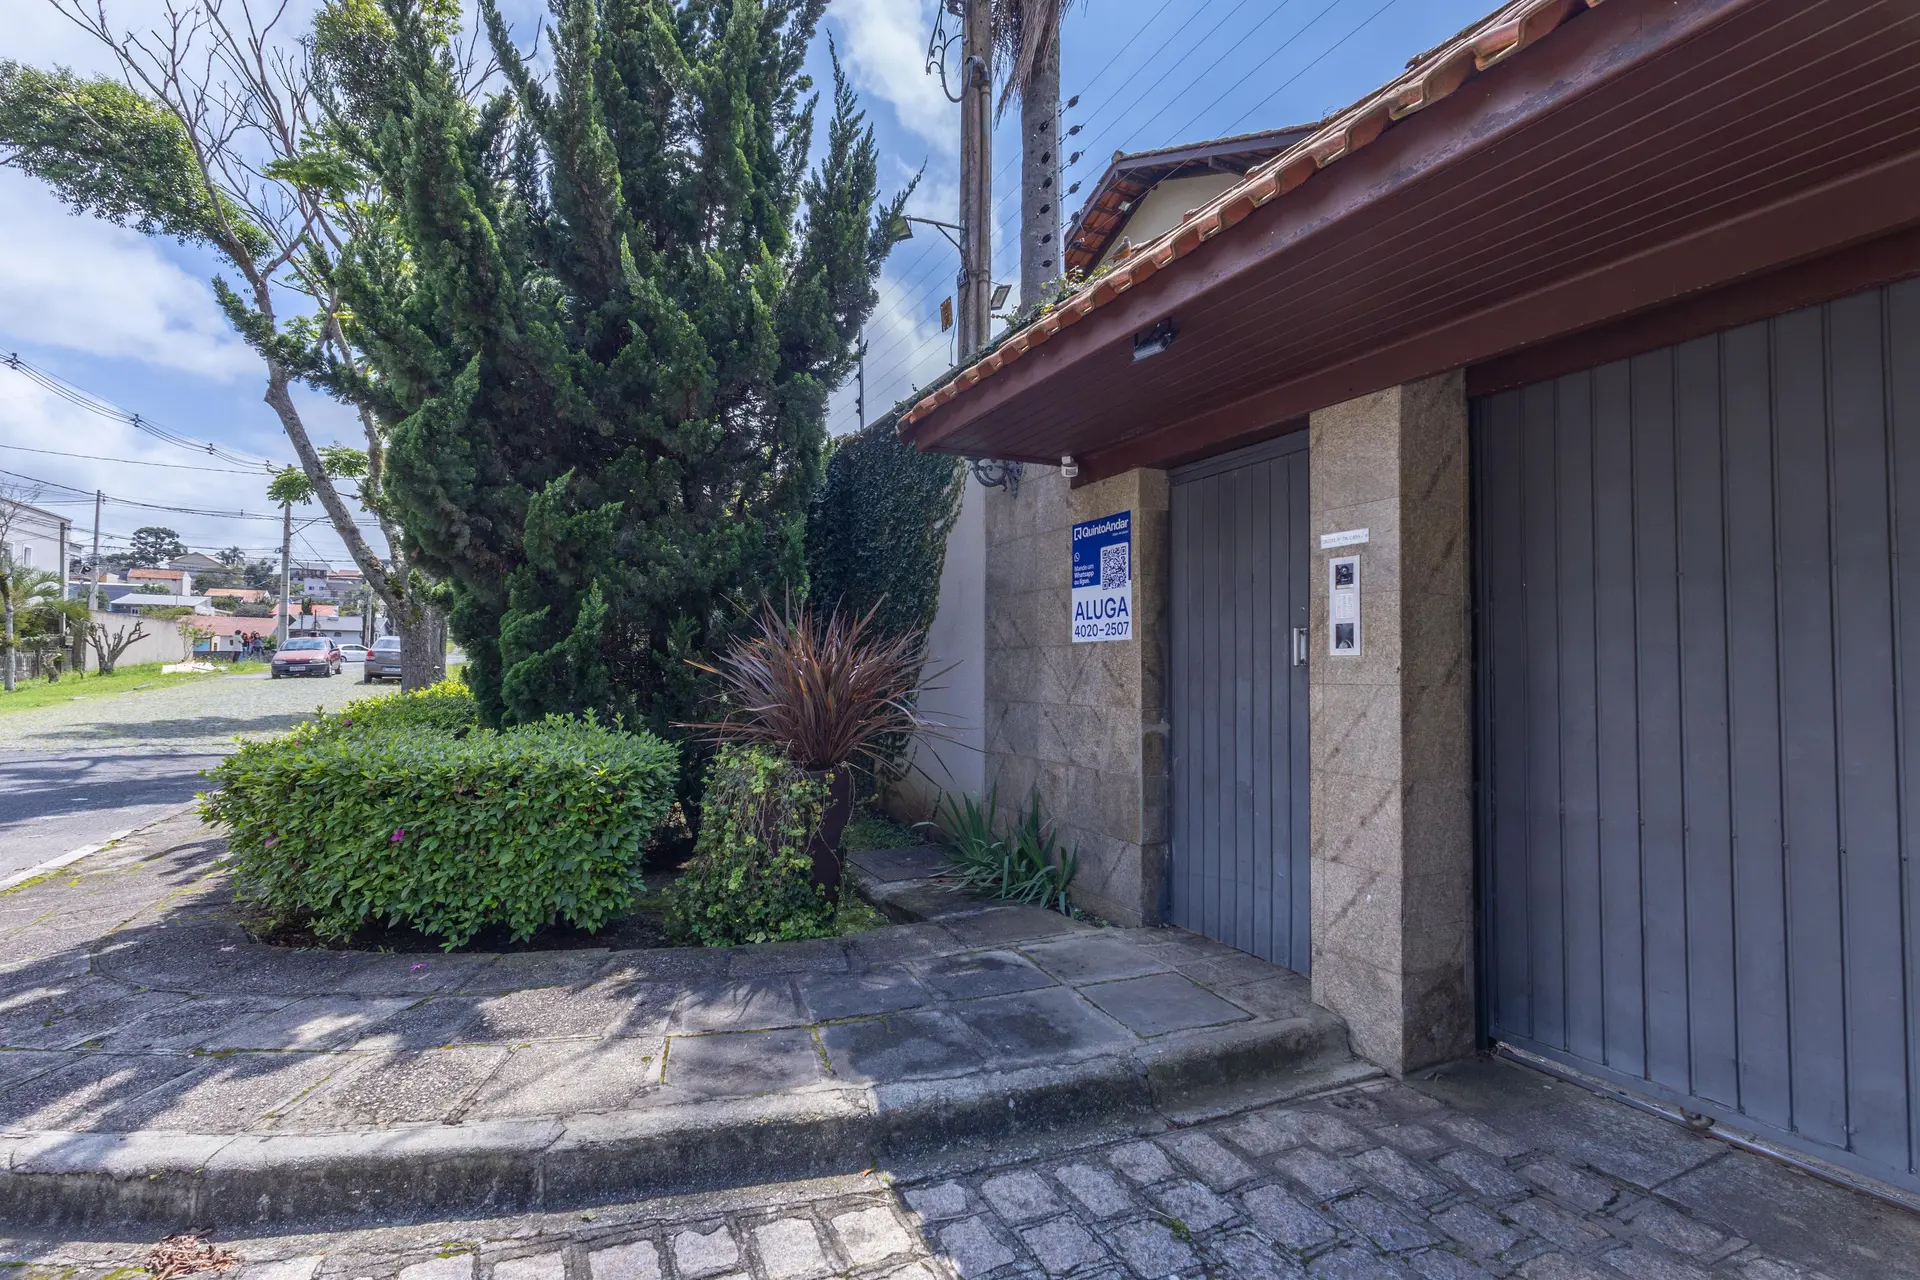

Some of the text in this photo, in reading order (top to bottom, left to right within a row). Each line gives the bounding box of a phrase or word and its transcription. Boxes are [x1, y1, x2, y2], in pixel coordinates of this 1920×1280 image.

[1082, 518, 1129, 538] QuintoAndar
[1074, 596, 1129, 621] ALUGA
[1074, 621, 1129, 638] 4020-2507
